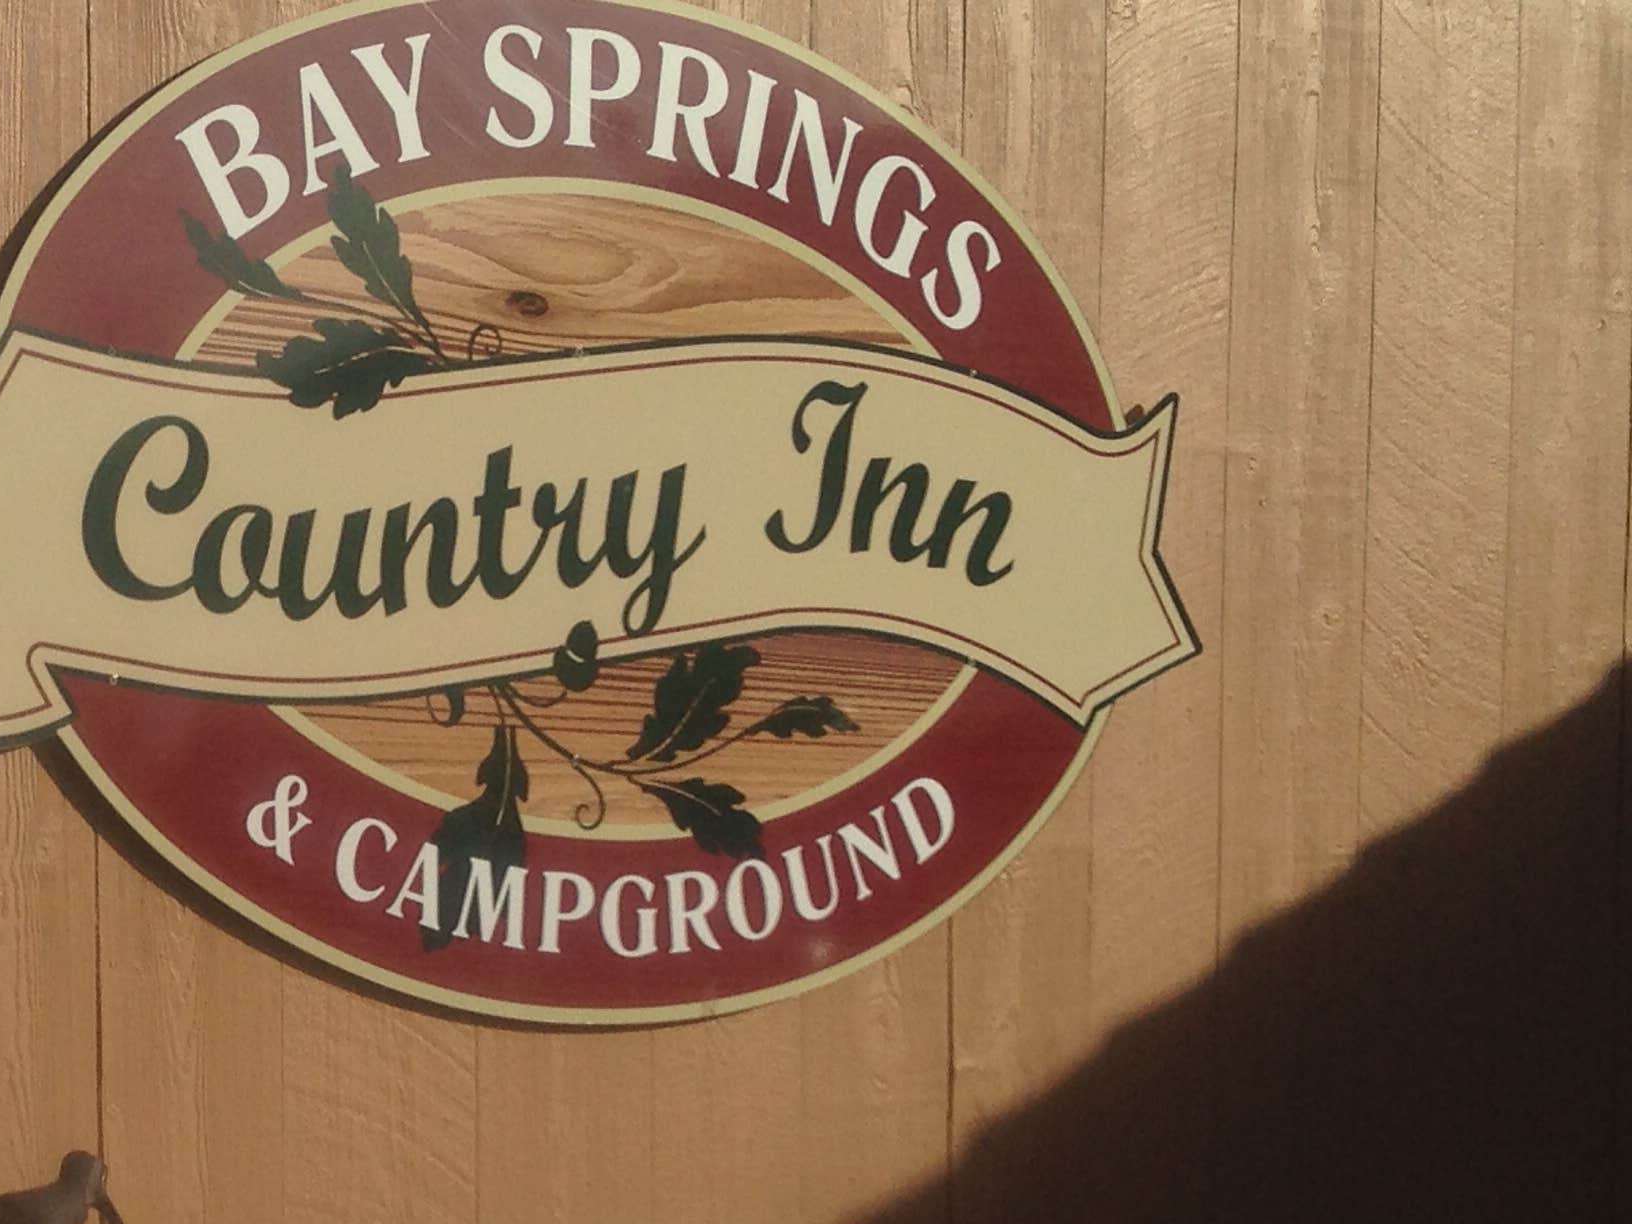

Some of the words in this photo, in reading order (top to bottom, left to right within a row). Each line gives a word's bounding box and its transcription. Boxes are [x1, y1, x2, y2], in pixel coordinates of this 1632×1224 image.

[175, 33, 431, 240] BAY
[483, 24, 1002, 330] SPRINGS
[81, 415, 707, 636] Country
[764, 380, 1015, 587] Inn
[244, 774, 314, 867] &
[334, 776, 956, 959] CAMPGROUND
